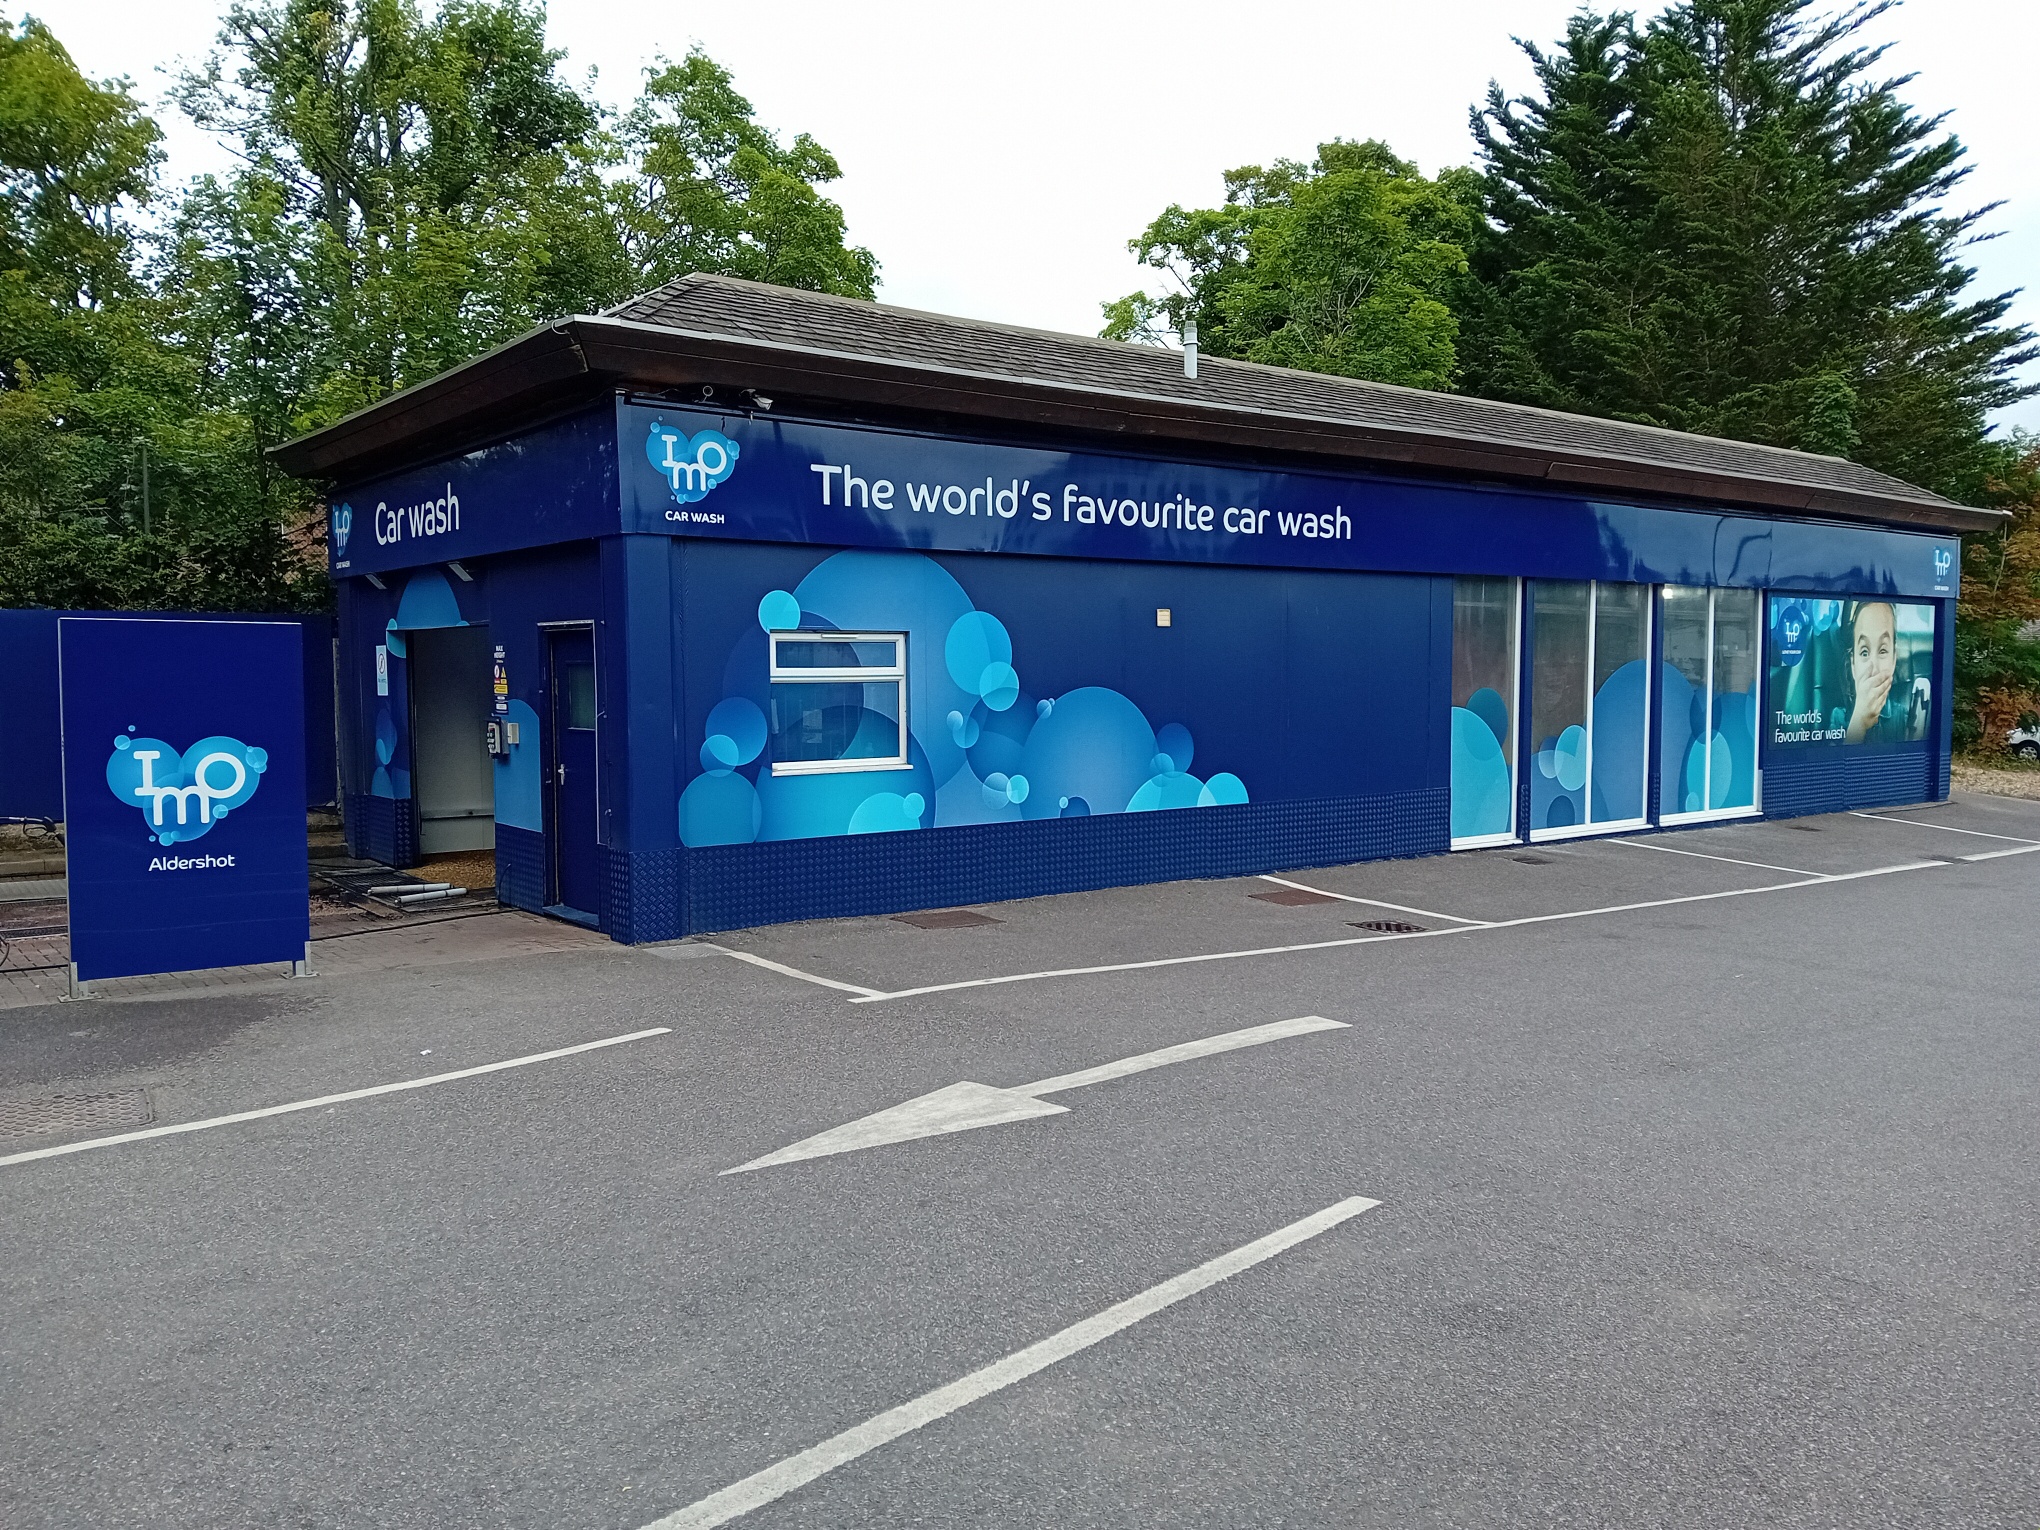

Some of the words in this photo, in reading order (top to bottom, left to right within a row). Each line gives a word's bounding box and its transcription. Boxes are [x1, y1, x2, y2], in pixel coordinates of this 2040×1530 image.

[811, 464, 895, 511] The
[906, 479, 1053, 521] world's
[1062, 484, 1215, 533] favourite
[1223, 508, 1271, 534] car
[1277, 506, 1351, 540] wash
[375, 501, 405, 546] Car
[408, 482, 460, 539] wash
[665, 510, 689, 522] CAR
[690, 512, 725, 524] WASH
[1775, 710, 1792, 725] The
[1774, 728, 1811, 743] favourite
[1811, 729, 1824, 741] car
[1825, 725, 1846, 740] wash
[148, 854, 235, 872] Aldershot
